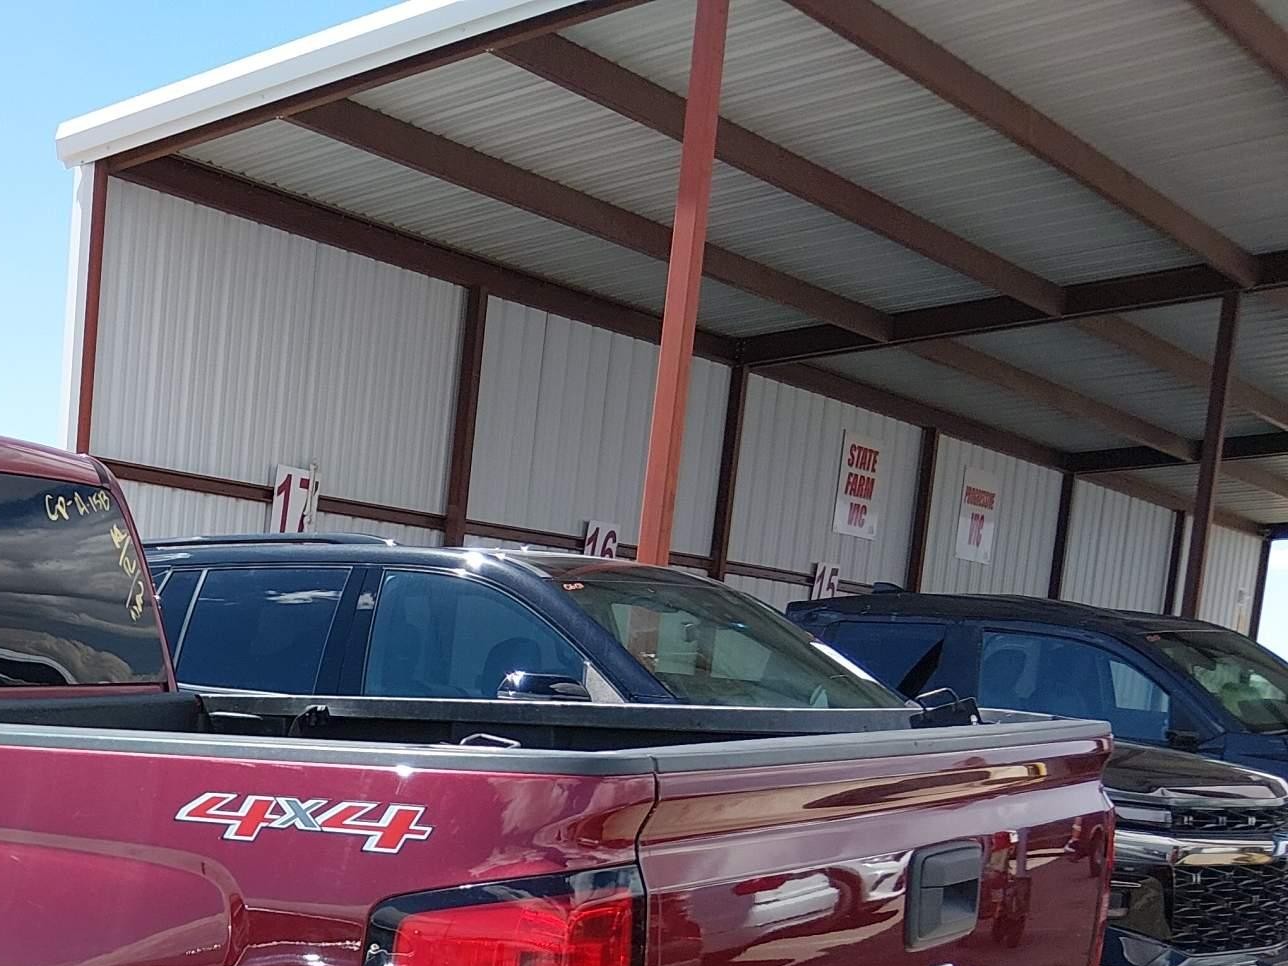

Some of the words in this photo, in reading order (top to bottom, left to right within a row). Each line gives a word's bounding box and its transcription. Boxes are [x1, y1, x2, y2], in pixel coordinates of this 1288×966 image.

[847, 443, 880, 473] STATE
[844, 471, 876, 500] FARM
[847, 502, 868, 528] VIC
[586, 527, 617, 558] 16
[815, 565, 840, 600] 15
